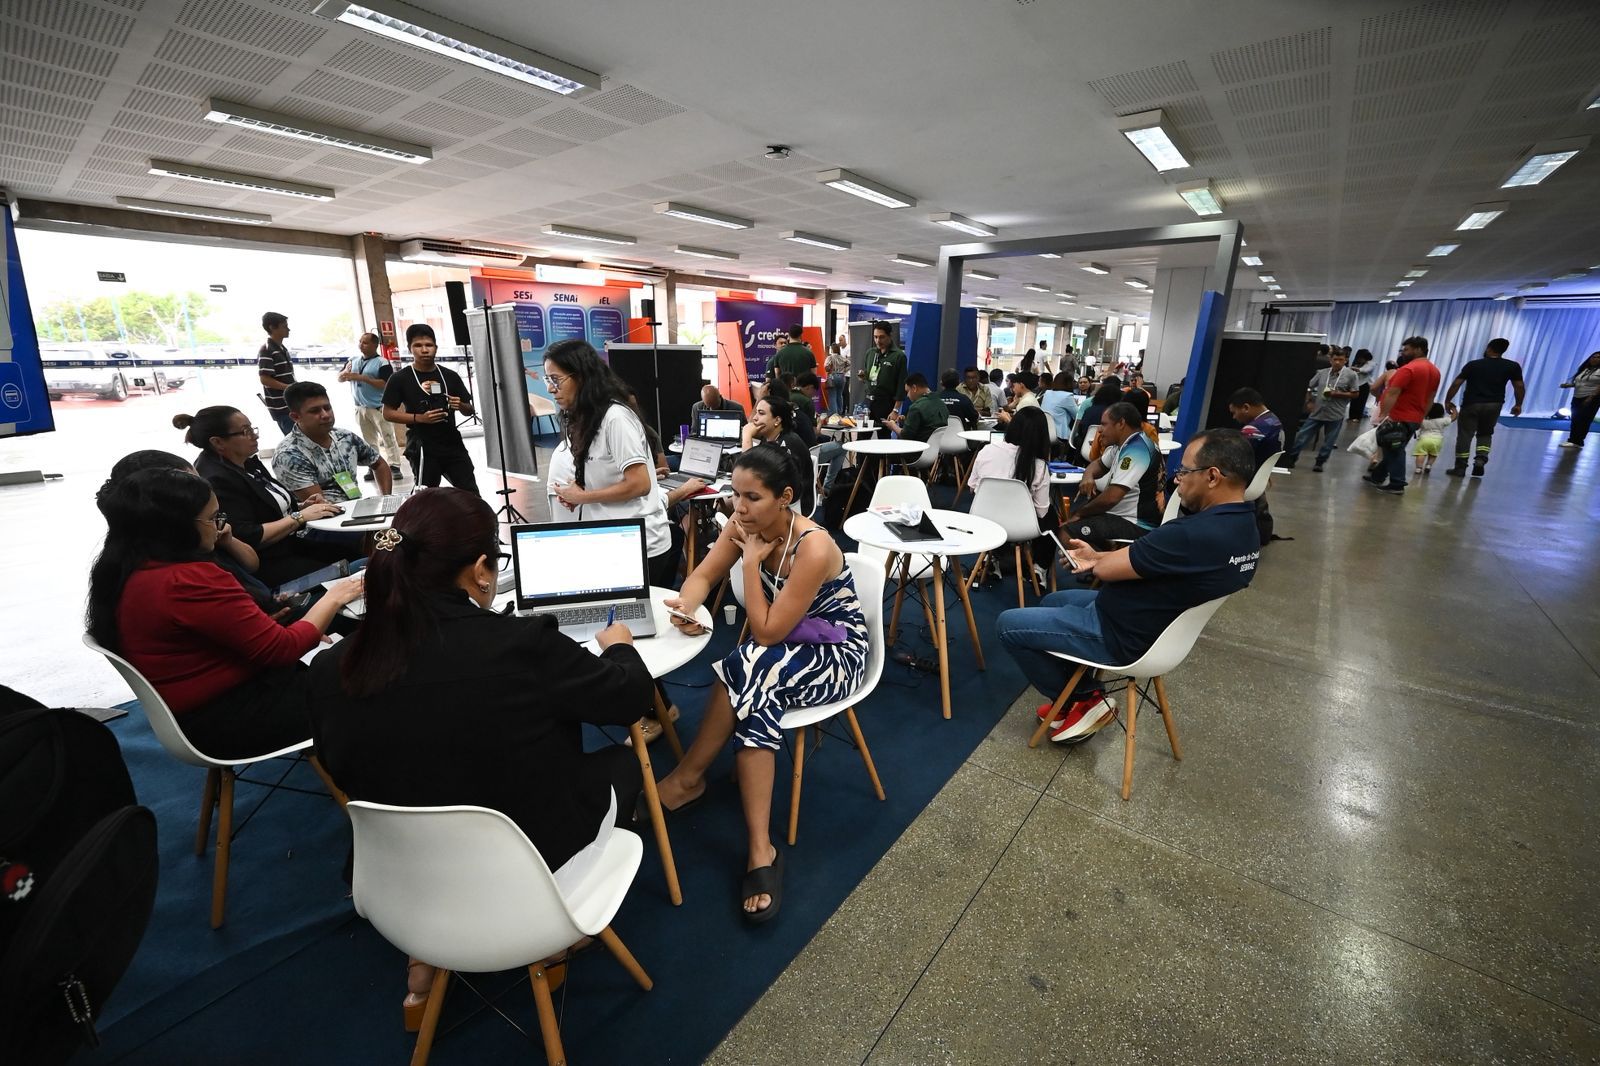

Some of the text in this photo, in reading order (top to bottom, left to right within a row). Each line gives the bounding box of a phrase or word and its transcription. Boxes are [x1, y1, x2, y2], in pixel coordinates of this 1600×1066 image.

[513, 290, 533, 300] SESi
[553, 293, 578, 303] SENAi
[599, 296, 610, 305] iEL
[1228, 556, 1246, 565] Agente
